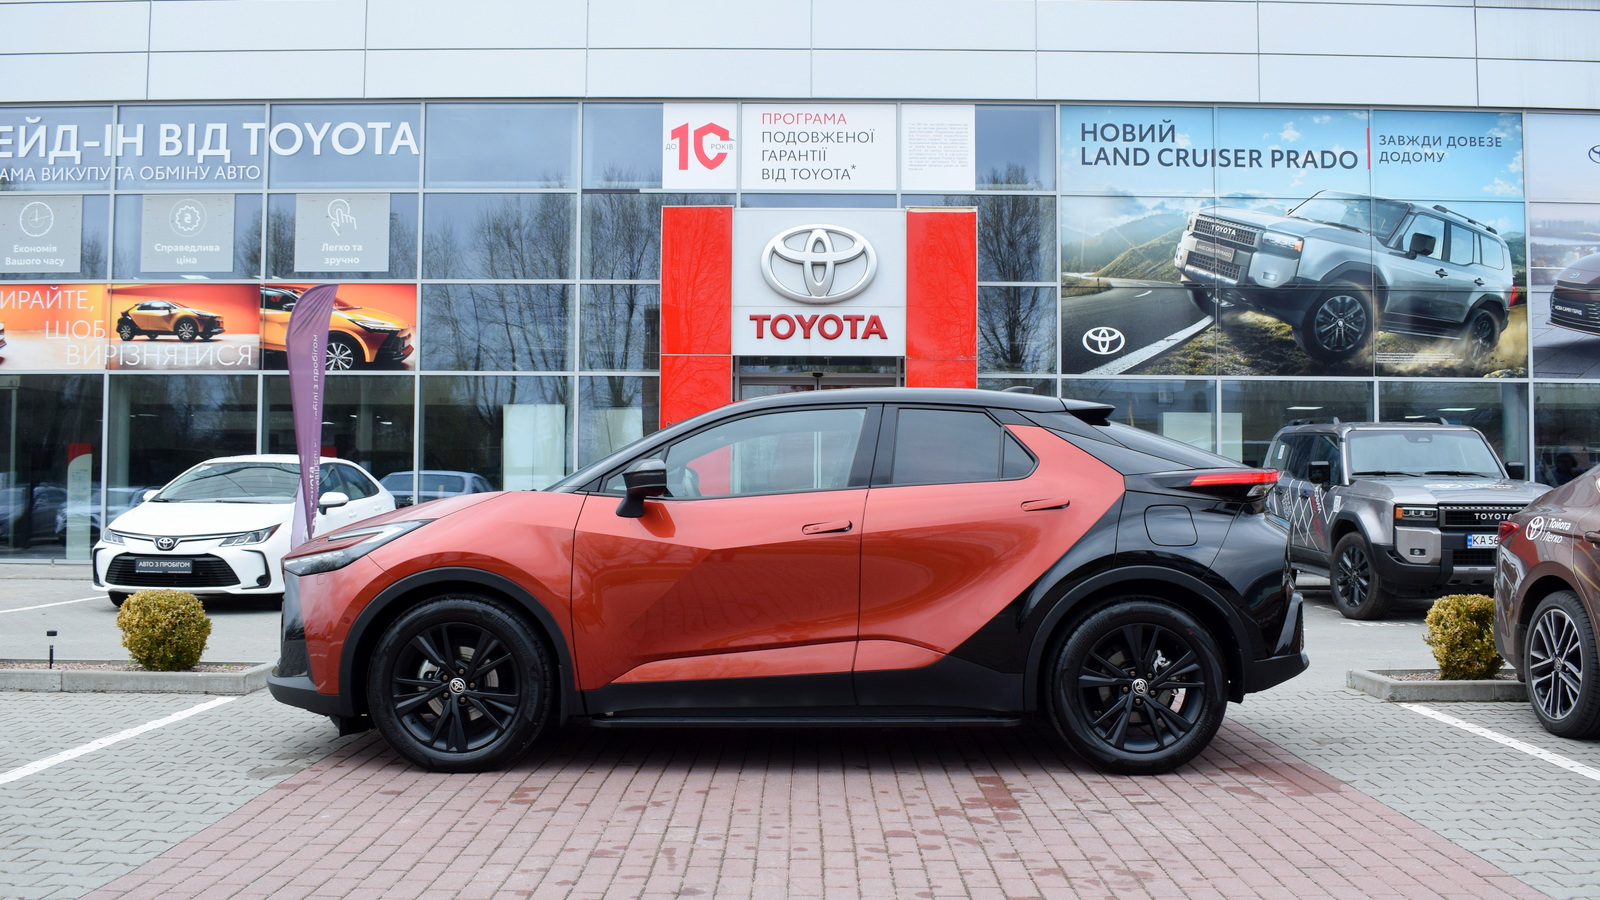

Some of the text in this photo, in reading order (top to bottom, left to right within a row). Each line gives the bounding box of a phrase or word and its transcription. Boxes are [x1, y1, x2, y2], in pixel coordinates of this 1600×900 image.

[761, 113, 847, 125] ПРОГРАМА
[761, 128, 875, 145] ПОДОВЖЕНОЇ
[1080, 118, 1176, 143] НОВИЙ
[159, 123, 231, 164] ВІД
[243, 121, 420, 156] TOYOTA
[665, 143, 677, 151] ДО
[710, 143, 734, 151] РОКІВ
[1379, 134, 1503, 149] ЗАВЖДИ ДОВЕЗЕ
[761, 146, 827, 162] ГАРАНТІЇ
[1080, 147, 1359, 170] LAND CRUISER PRADO
[1378, 151, 1446, 165] ДОДОМУ
[41, 166, 112, 181] ВИКУПУ
[115, 166, 136, 180] ТА
[139, 165, 211, 181] ОБМІНУ
[213, 164, 262, 180] АВТО
[761, 168, 787, 182] ВІД
[1211, 224, 1236, 236] TOYOTA
[13, 244, 58, 253] Економія
[154, 243, 221, 254] Справедлива
[321, 243, 363, 252] Легко та
[5, 256, 65, 267] Вашого часу
[176, 255, 198, 266] ціна
[324, 257, 360, 267] зручно
[46, 320, 106, 342] ЩОБ
[749, 314, 888, 340] TOYOTA
[66, 343, 253, 366] ВИРІЗНЯТИСЯ
[311, 334, 320, 382] пробігом
[1549, 518, 1572, 531] Тойота
[1472, 535, 1487, 545] KA
